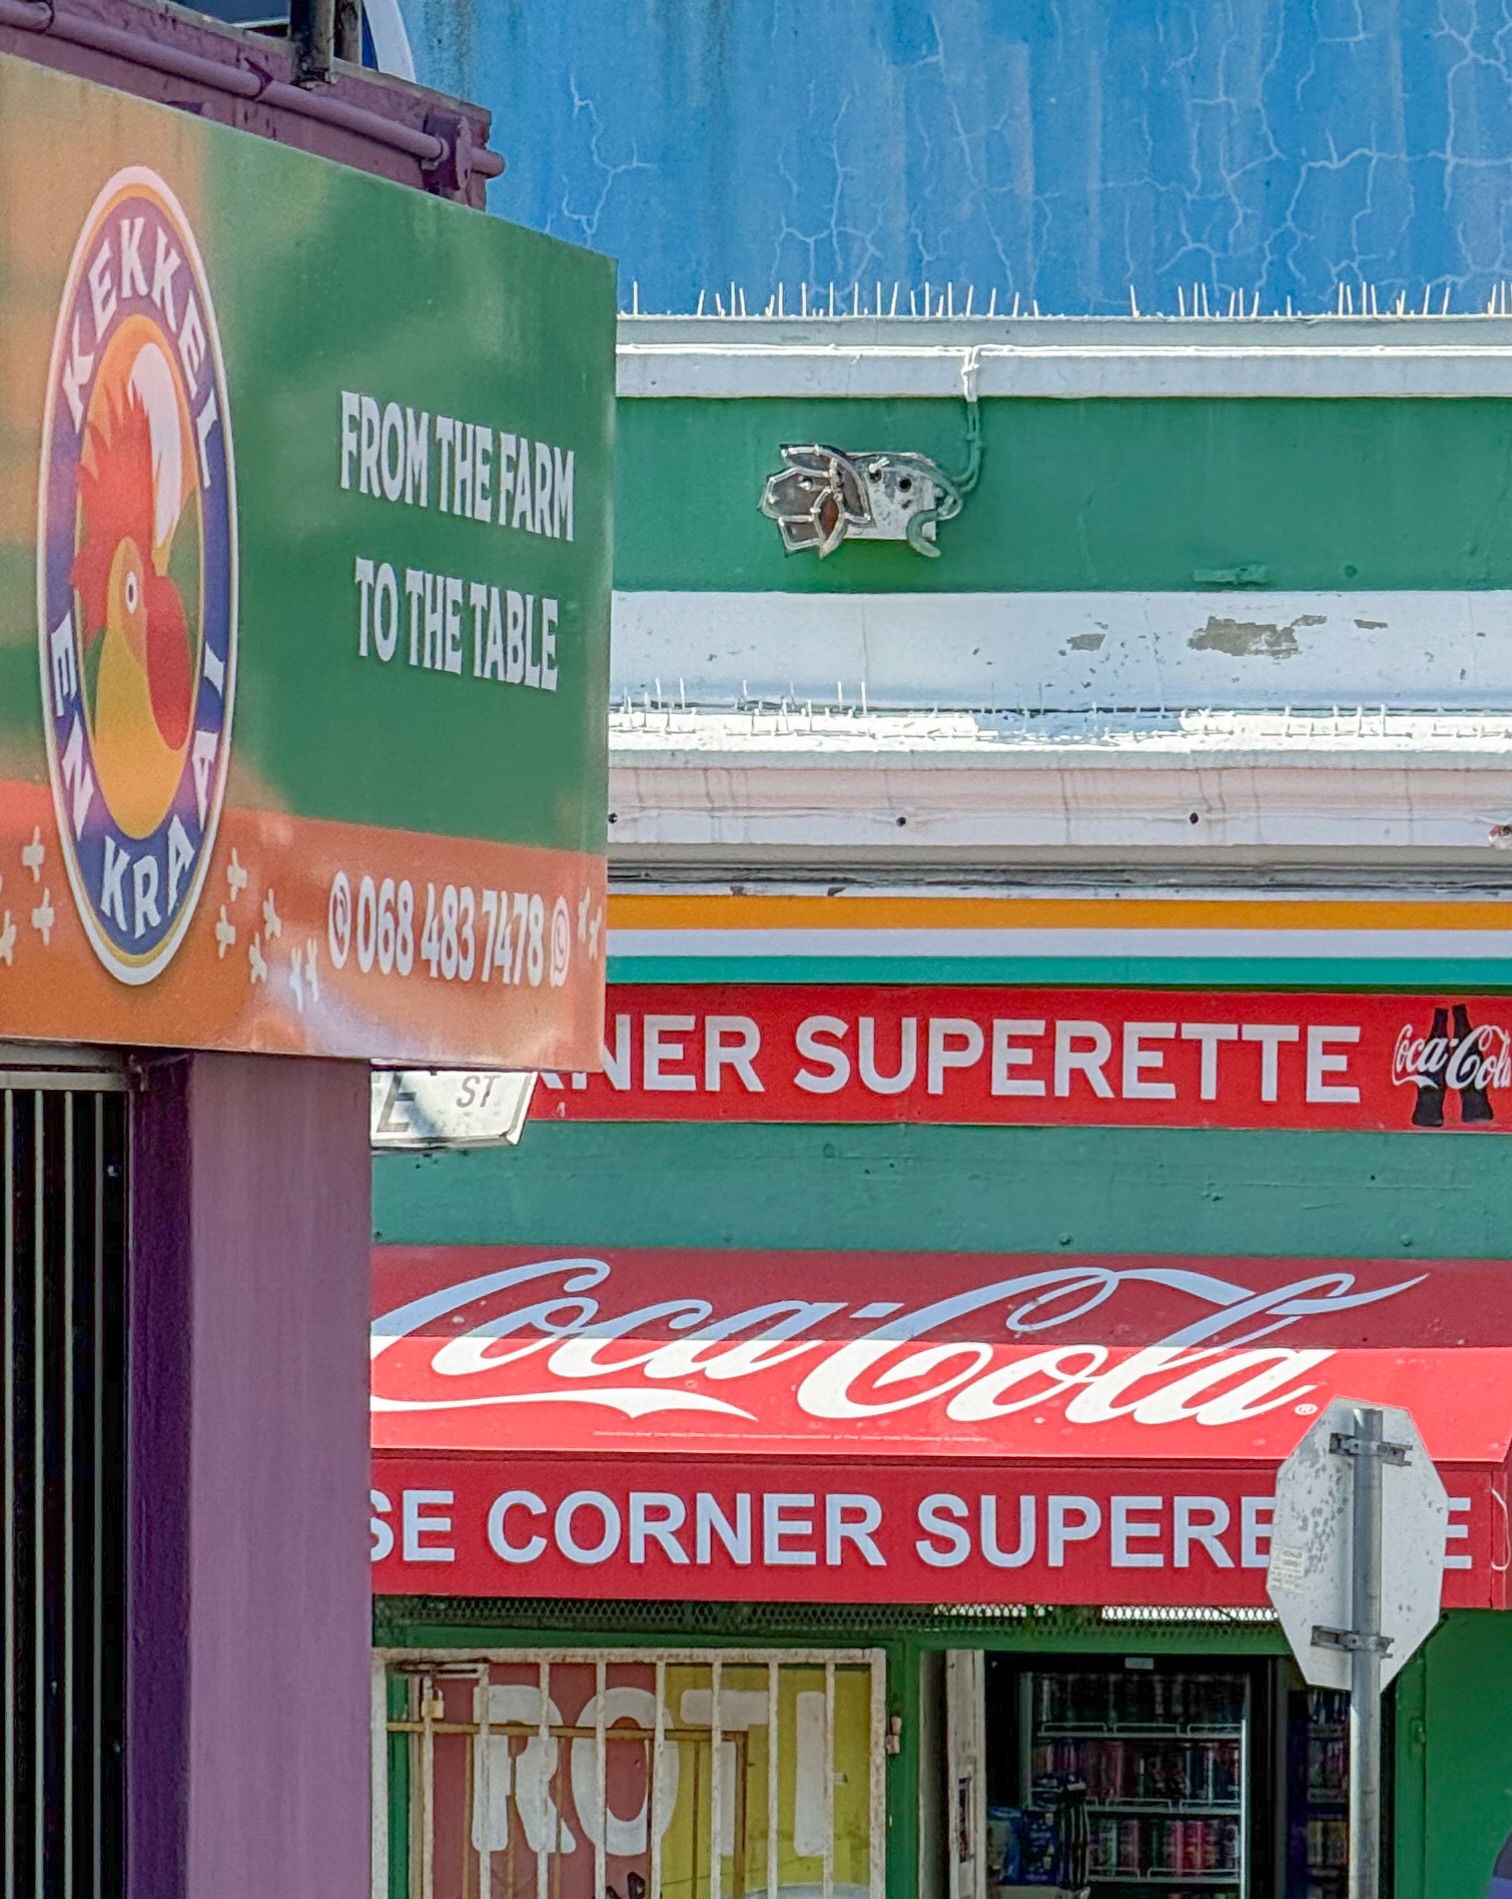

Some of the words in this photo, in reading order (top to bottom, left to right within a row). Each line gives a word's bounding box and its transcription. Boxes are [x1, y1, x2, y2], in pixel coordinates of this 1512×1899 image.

[62, 217, 218, 489] KEKKEL
[341, 390, 429, 507] FROM
[436, 415, 493, 522] THE
[498, 431, 574, 541] FARM
[354, 555, 398, 662] TO
[406, 568, 463, 674] THE
[470, 581, 558, 691] TABLE
[51, 610, 95, 842] EN
[356, 875, 414, 978] 068
[420, 882, 475, 981] 483
[481, 888, 545, 987] 7478
[455, 1073, 501, 1108] ST
[793, 1015, 1361, 1104] SUPERETTE
[1391, 1024, 1512, 1090] Coca-Cola
[370, 1257, 1430, 1427] Coca-Cola
[487, 1489, 888, 1566] CORNER
[471, 1685, 833, 1857] ROTI
